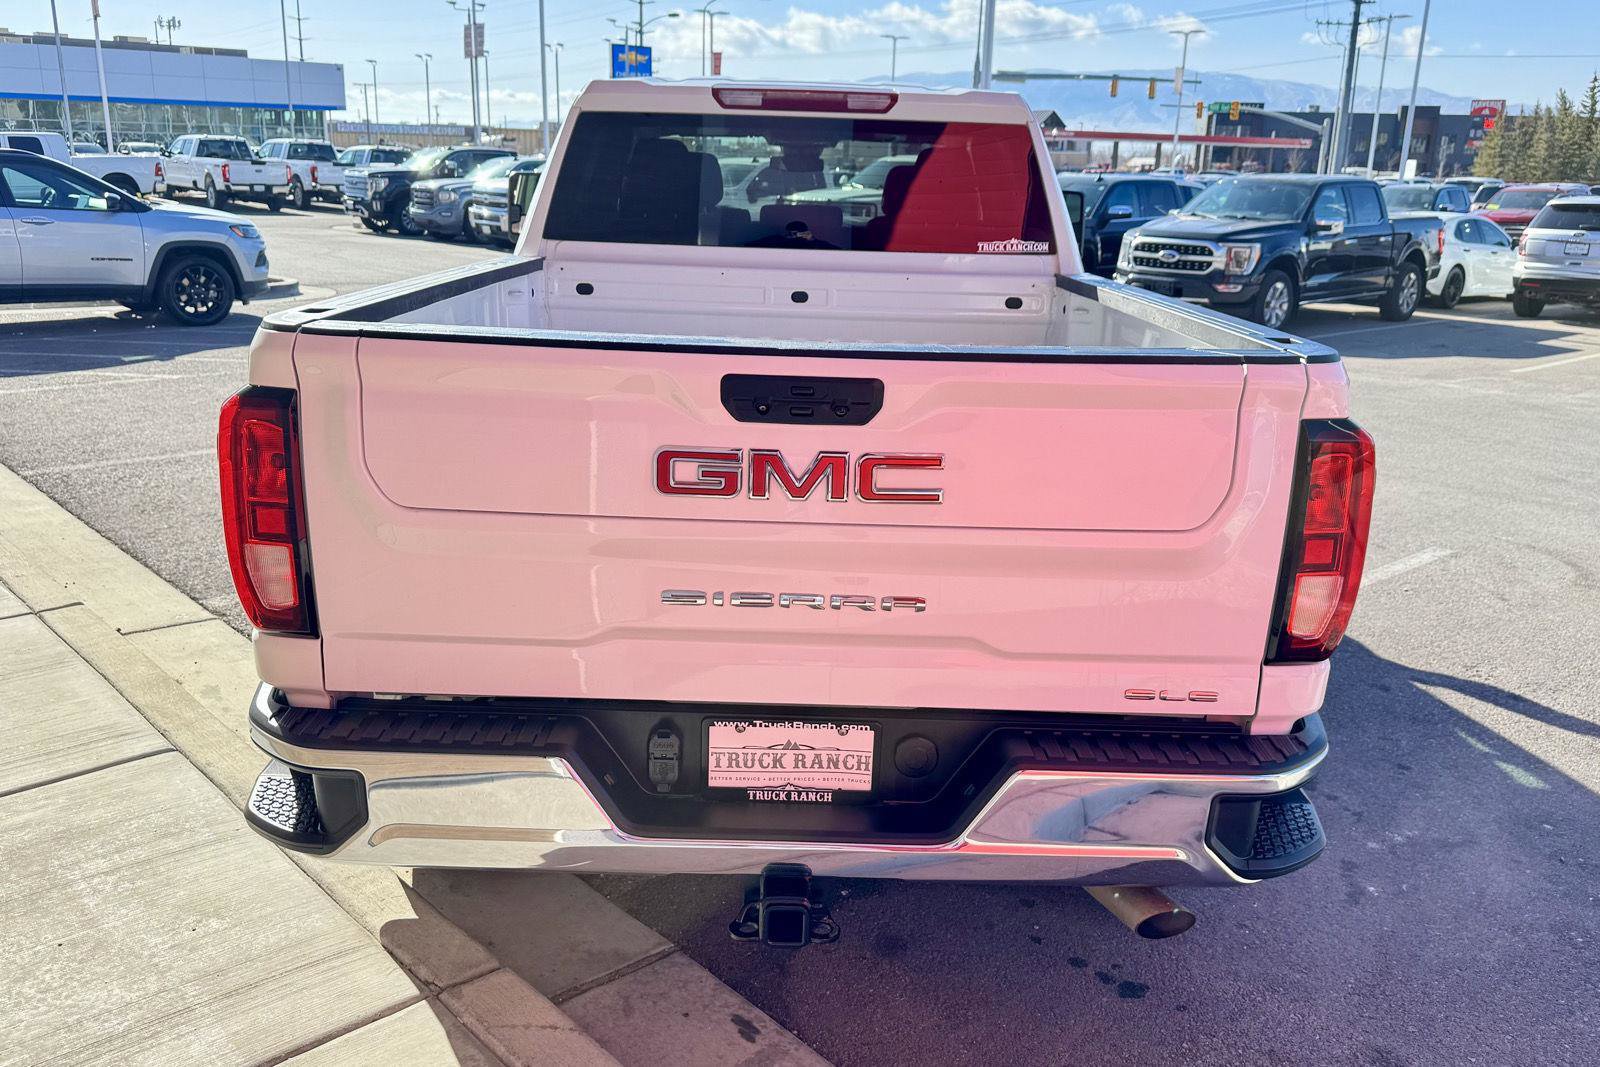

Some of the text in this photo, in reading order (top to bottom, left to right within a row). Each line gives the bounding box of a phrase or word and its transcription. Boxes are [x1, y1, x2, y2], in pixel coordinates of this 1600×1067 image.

[653, 444, 945, 504] GMC
[660, 589, 927, 611] SIERRA
[1124, 688, 1219, 702] SLE
[713, 720, 871, 732] www.TruckRanch.com
[710, 751, 871, 772] TRUCK RANCH
[747, 790, 833, 802] TRUCK RANCH
